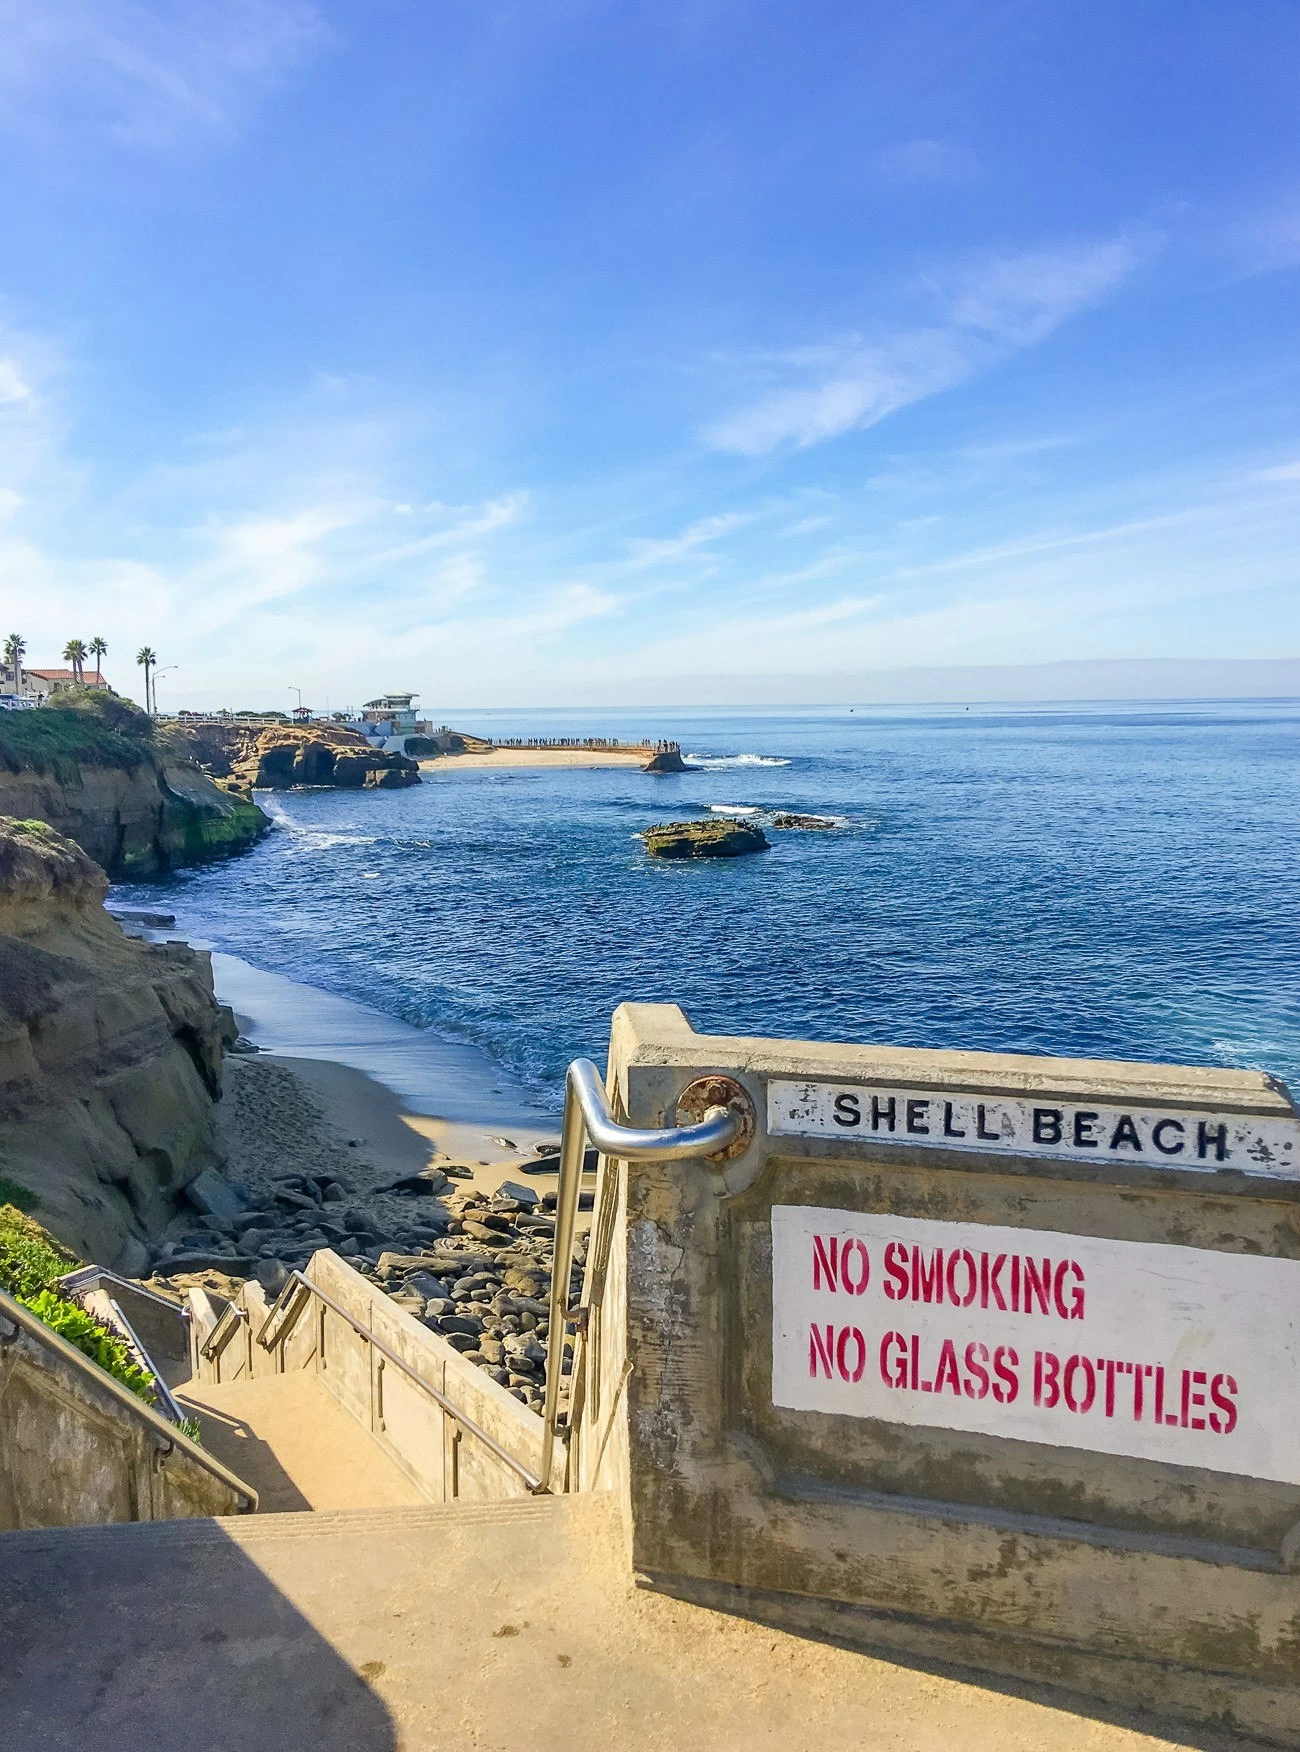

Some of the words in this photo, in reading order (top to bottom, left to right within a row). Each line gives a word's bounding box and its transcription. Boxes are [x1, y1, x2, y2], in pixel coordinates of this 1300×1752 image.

[833, 1093, 1002, 1142] SHELL
[1032, 1107, 1228, 1161] BEACH
[812, 1235, 870, 1296] NO
[883, 1242, 1086, 1319] SMOKING
[809, 1322, 867, 1383] NO
[879, 1331, 1019, 1403] GLASS
[1033, 1350, 1239, 1434] BOTTLES
